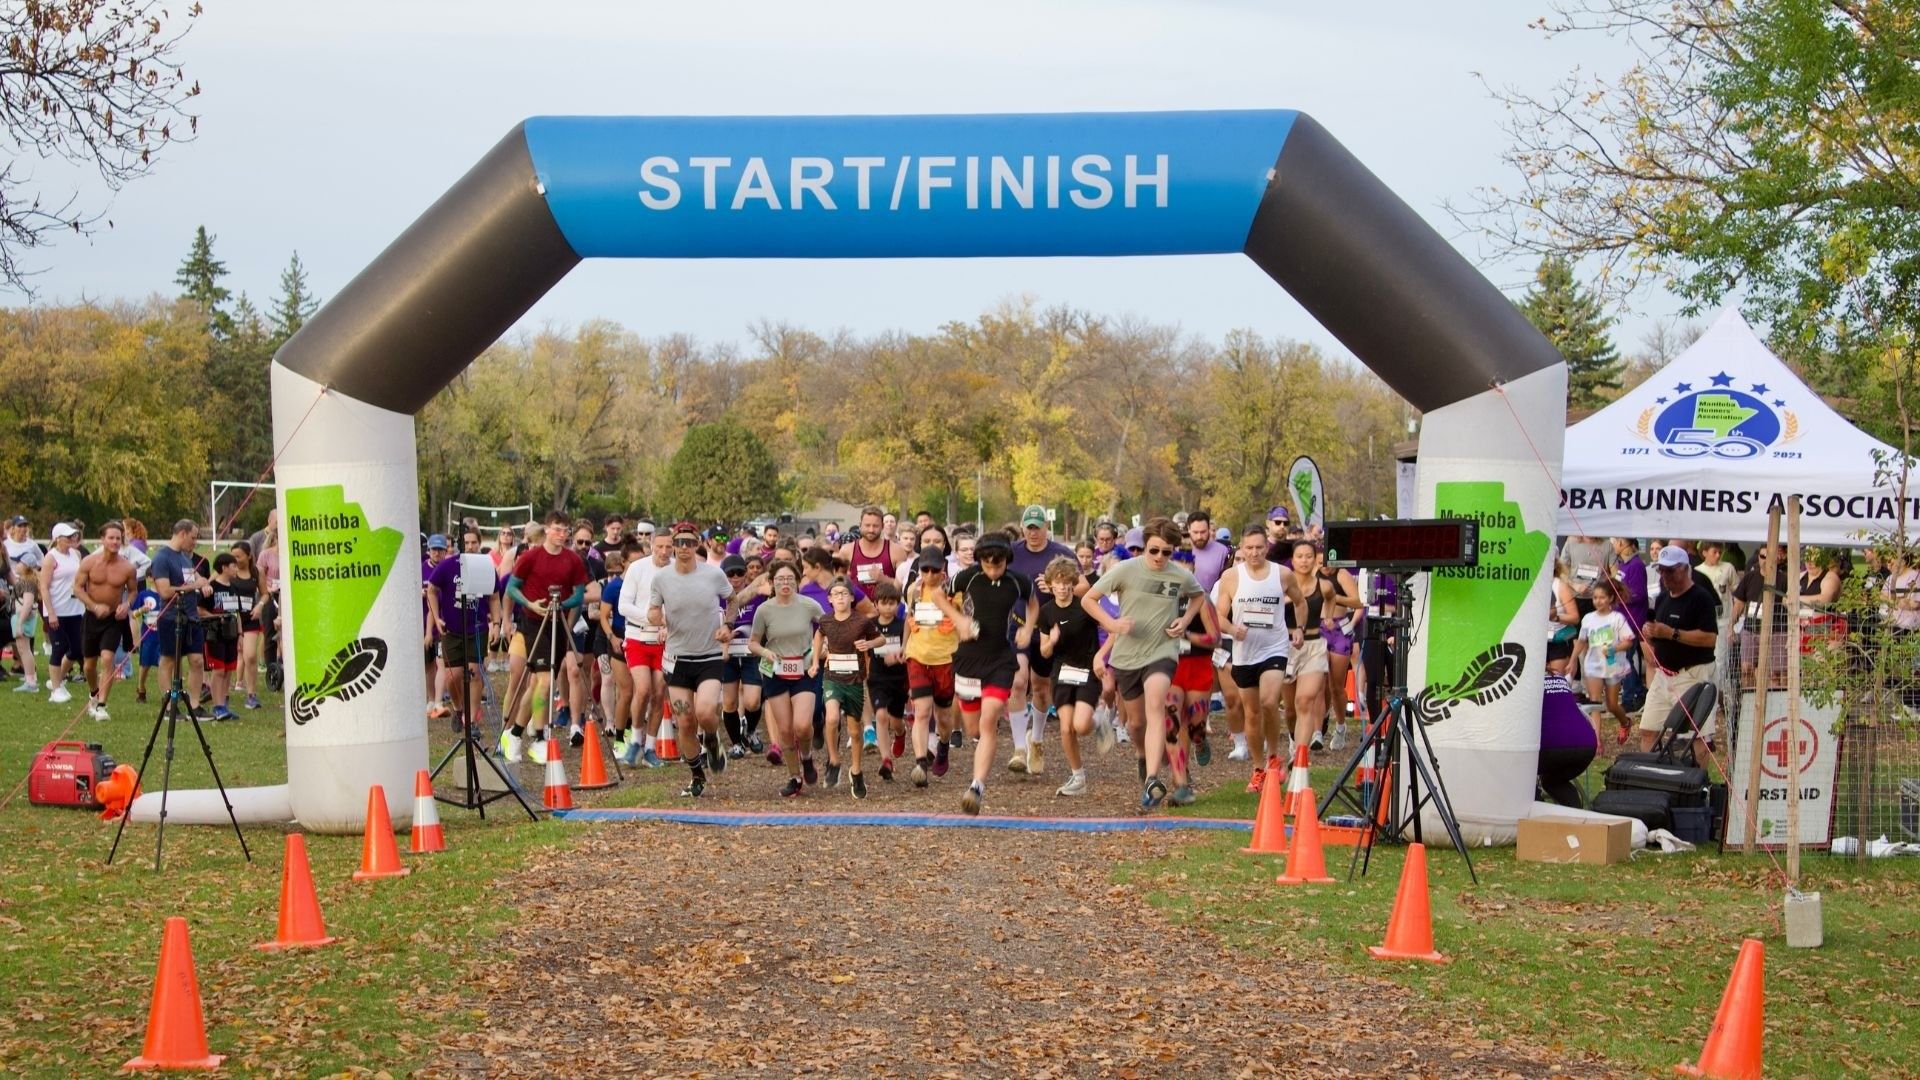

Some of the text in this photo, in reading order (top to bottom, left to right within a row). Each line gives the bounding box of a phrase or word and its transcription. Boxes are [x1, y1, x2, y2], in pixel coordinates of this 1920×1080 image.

[638, 154, 1169, 211] START/FINISH
[1621, 447, 1650, 456] 1971
[1772, 450, 1803, 460] 2021
[1615, 488, 1760, 514] RUNNERS'
[290, 513, 360, 532] Manitoba
[292, 537, 358, 557] Runners'
[293, 561, 381, 581] Association
[1436, 562, 1530, 581] Association
[782, 663, 798, 673] 683
[1745, 788, 1788, 801] RST
